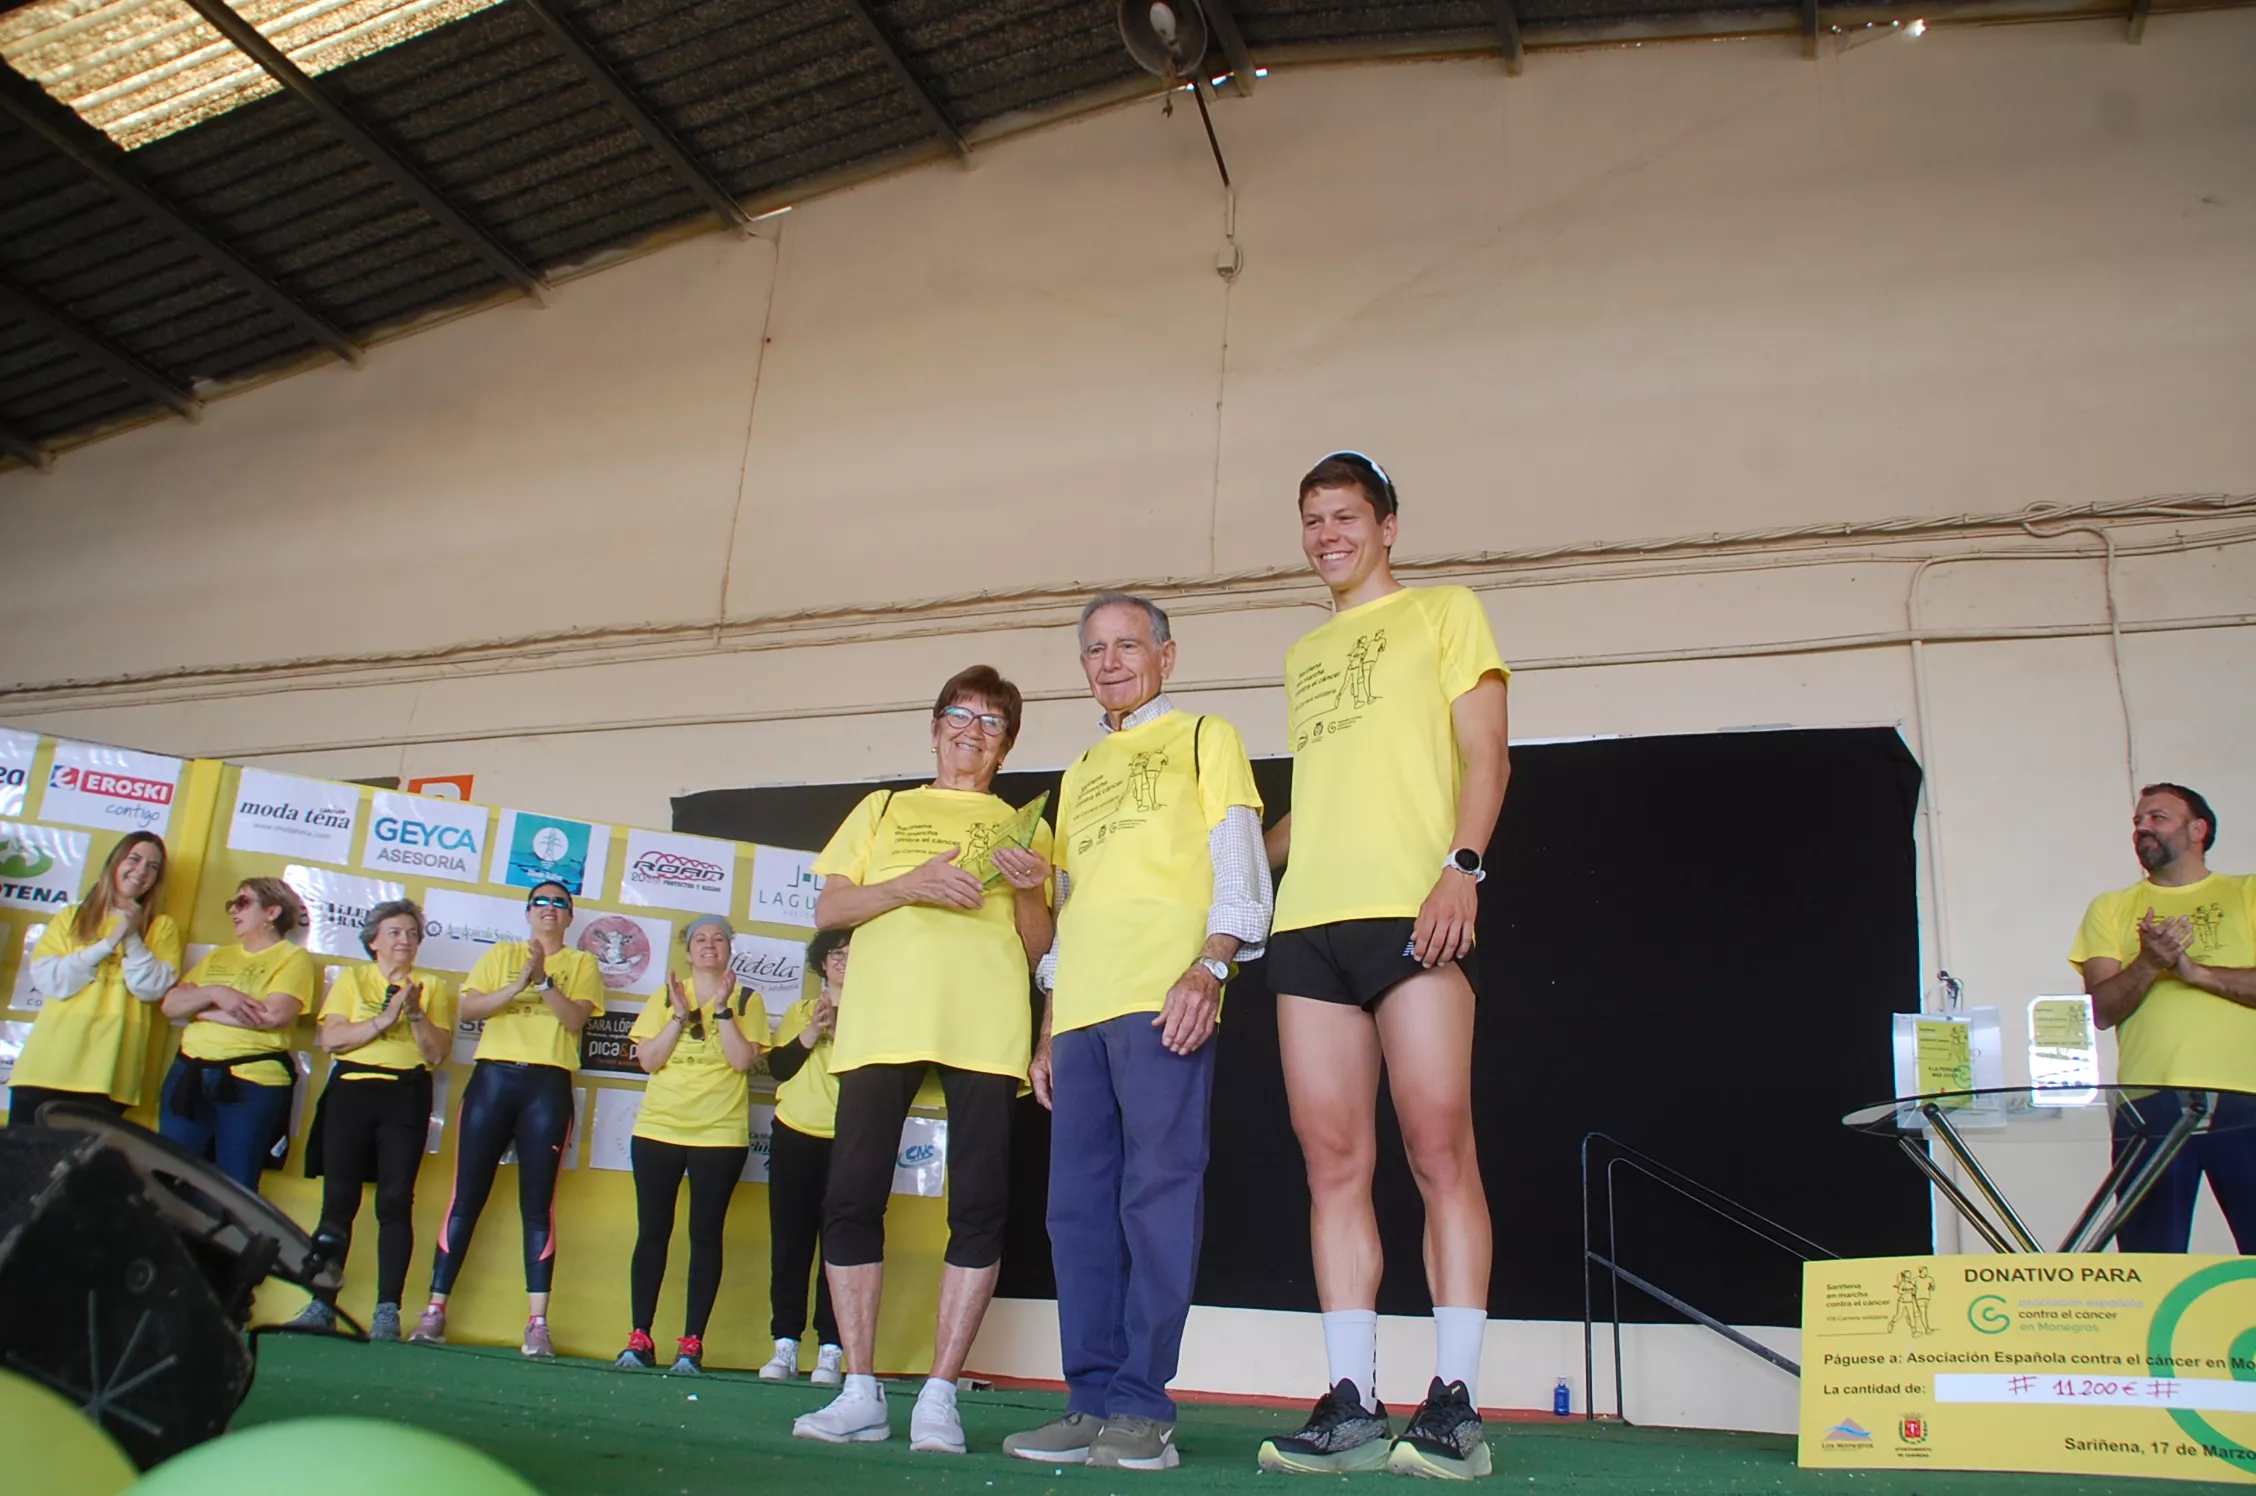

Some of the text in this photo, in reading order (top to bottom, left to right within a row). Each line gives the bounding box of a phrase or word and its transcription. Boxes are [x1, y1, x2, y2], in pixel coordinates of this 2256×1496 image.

[86, 774, 169, 801] EROSKI
[105, 803, 161, 828] contigo
[239, 801, 299, 821] moda
[303, 808, 351, 829] tena
[374, 816, 477, 854] GEYCA
[376, 847, 466, 872] ASESORIA
[0, 883, 69, 903] TENA
[586, 1019, 612, 1032] SARA
[1964, 1267, 2142, 1283] DONATIVO PARA
[1826, 1283, 1862, 1291] Sariñena
[1838, 1290, 1868, 1298] marcha
[1826, 1300, 1853, 1308] contra
[2018, 1297, 2143, 1310] asociación española
[2018, 1309, 2118, 1320] contra el cáncer
[2019, 1321, 2099, 1334] en Monegros
[1823, 1353, 1885, 1367] Páguese
[1889, 1354, 1902, 1364] a:
[1907, 1351, 1990, 1364] Asociación
[1994, 1351, 2066, 1366] Española
[2071, 1354, 2121, 1366] contra
[2127, 1354, 2140, 1366] el
[2145, 1354, 2200, 1368] cáncer
[2206, 1357, 2226, 1369] en
[1823, 1383, 1926, 1395] La cantidad de:
[2064, 1437, 2256, 1461] Sariñena, 17 de Marzo
